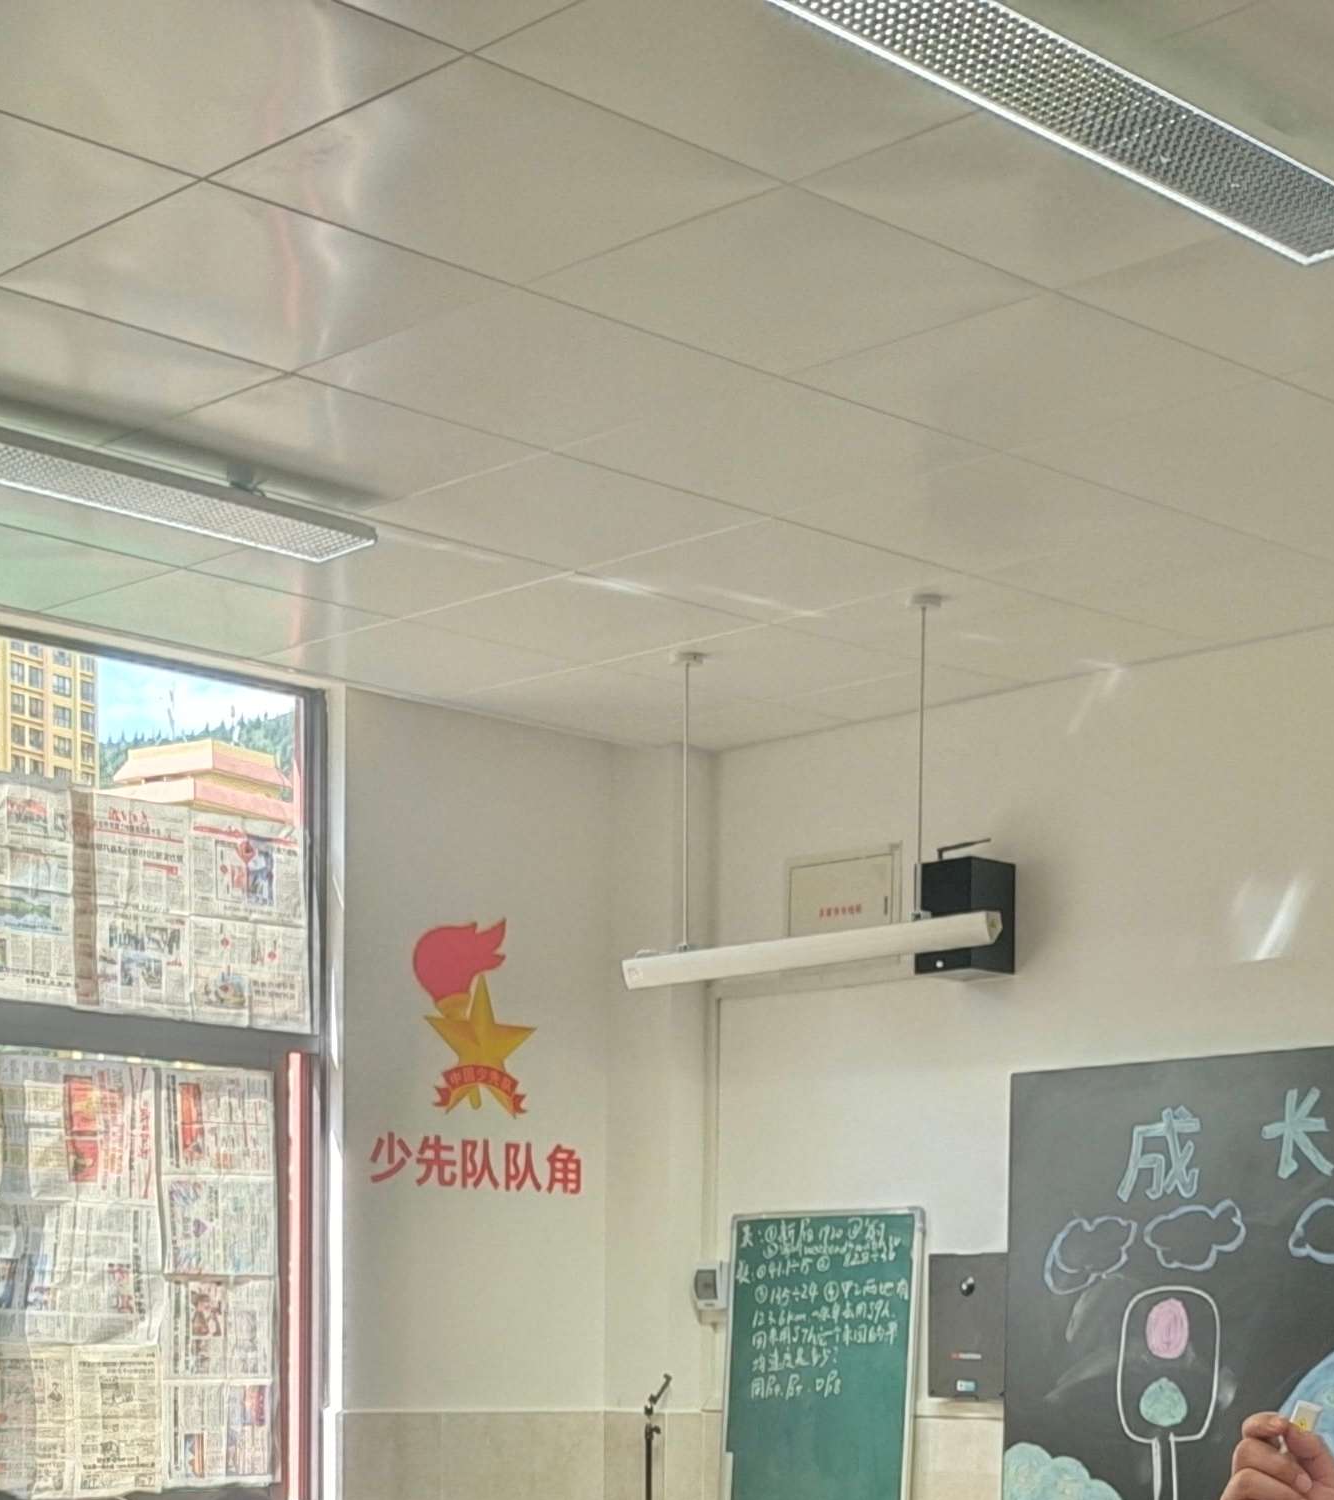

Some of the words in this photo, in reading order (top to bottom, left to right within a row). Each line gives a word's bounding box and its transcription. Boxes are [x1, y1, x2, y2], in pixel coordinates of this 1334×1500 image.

[370, 1131, 581, 1194] 少先队队角
